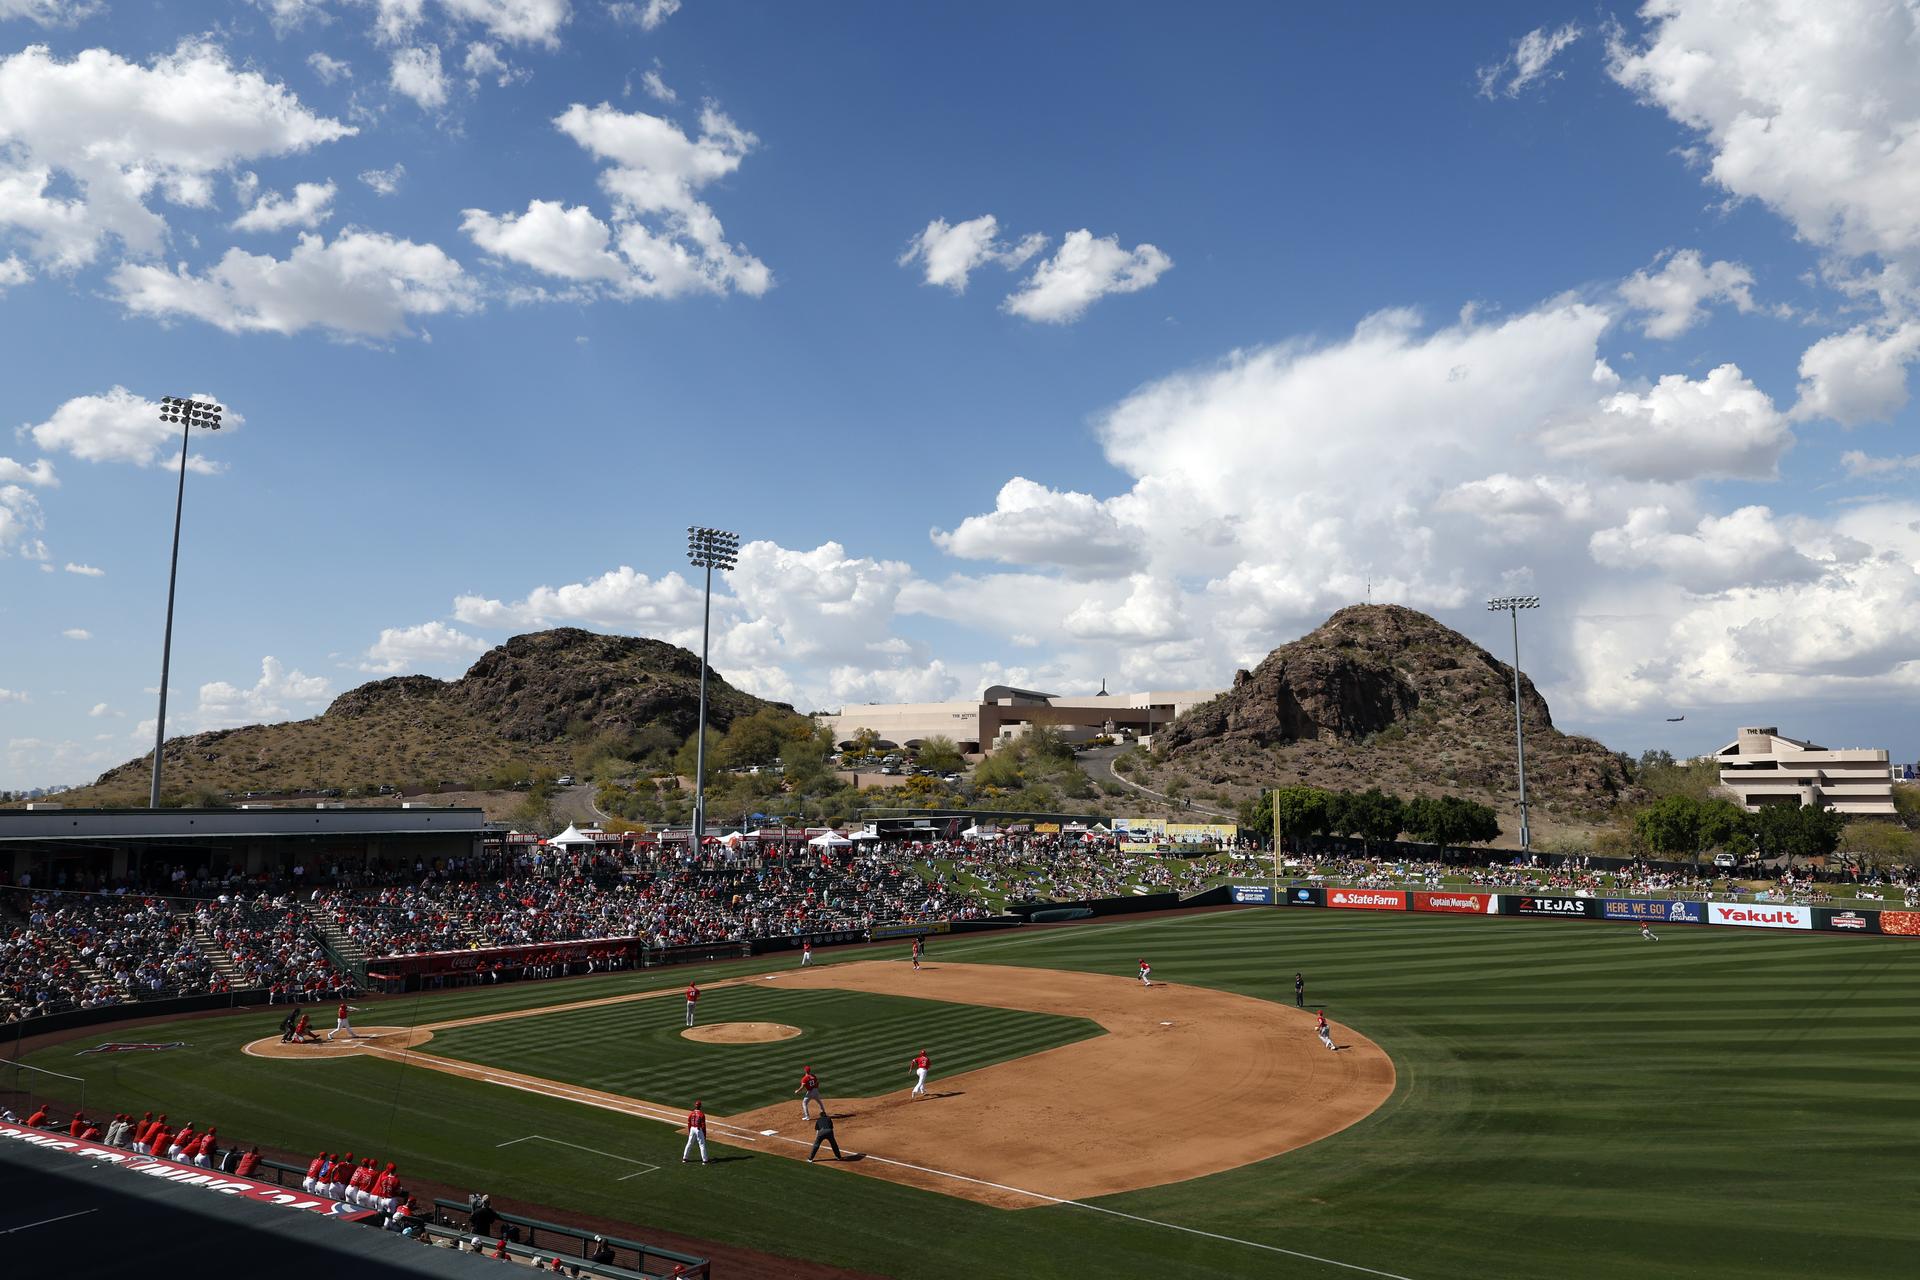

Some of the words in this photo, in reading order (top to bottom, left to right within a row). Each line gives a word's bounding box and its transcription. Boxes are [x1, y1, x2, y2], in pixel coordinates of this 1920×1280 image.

[1348, 893, 1372, 905] State
[1373, 895, 1399, 906] Farm
[1430, 897, 1450, 907] Captain
[1450, 898, 1473, 909] Morgan
[1534, 899, 1585, 912] TEJAS
[1606, 902, 1629, 914] HERE
[1632, 903, 1647, 914] WE
[1650, 904, 1665, 915] GO!
[1717, 908, 1799, 925] Yakult
